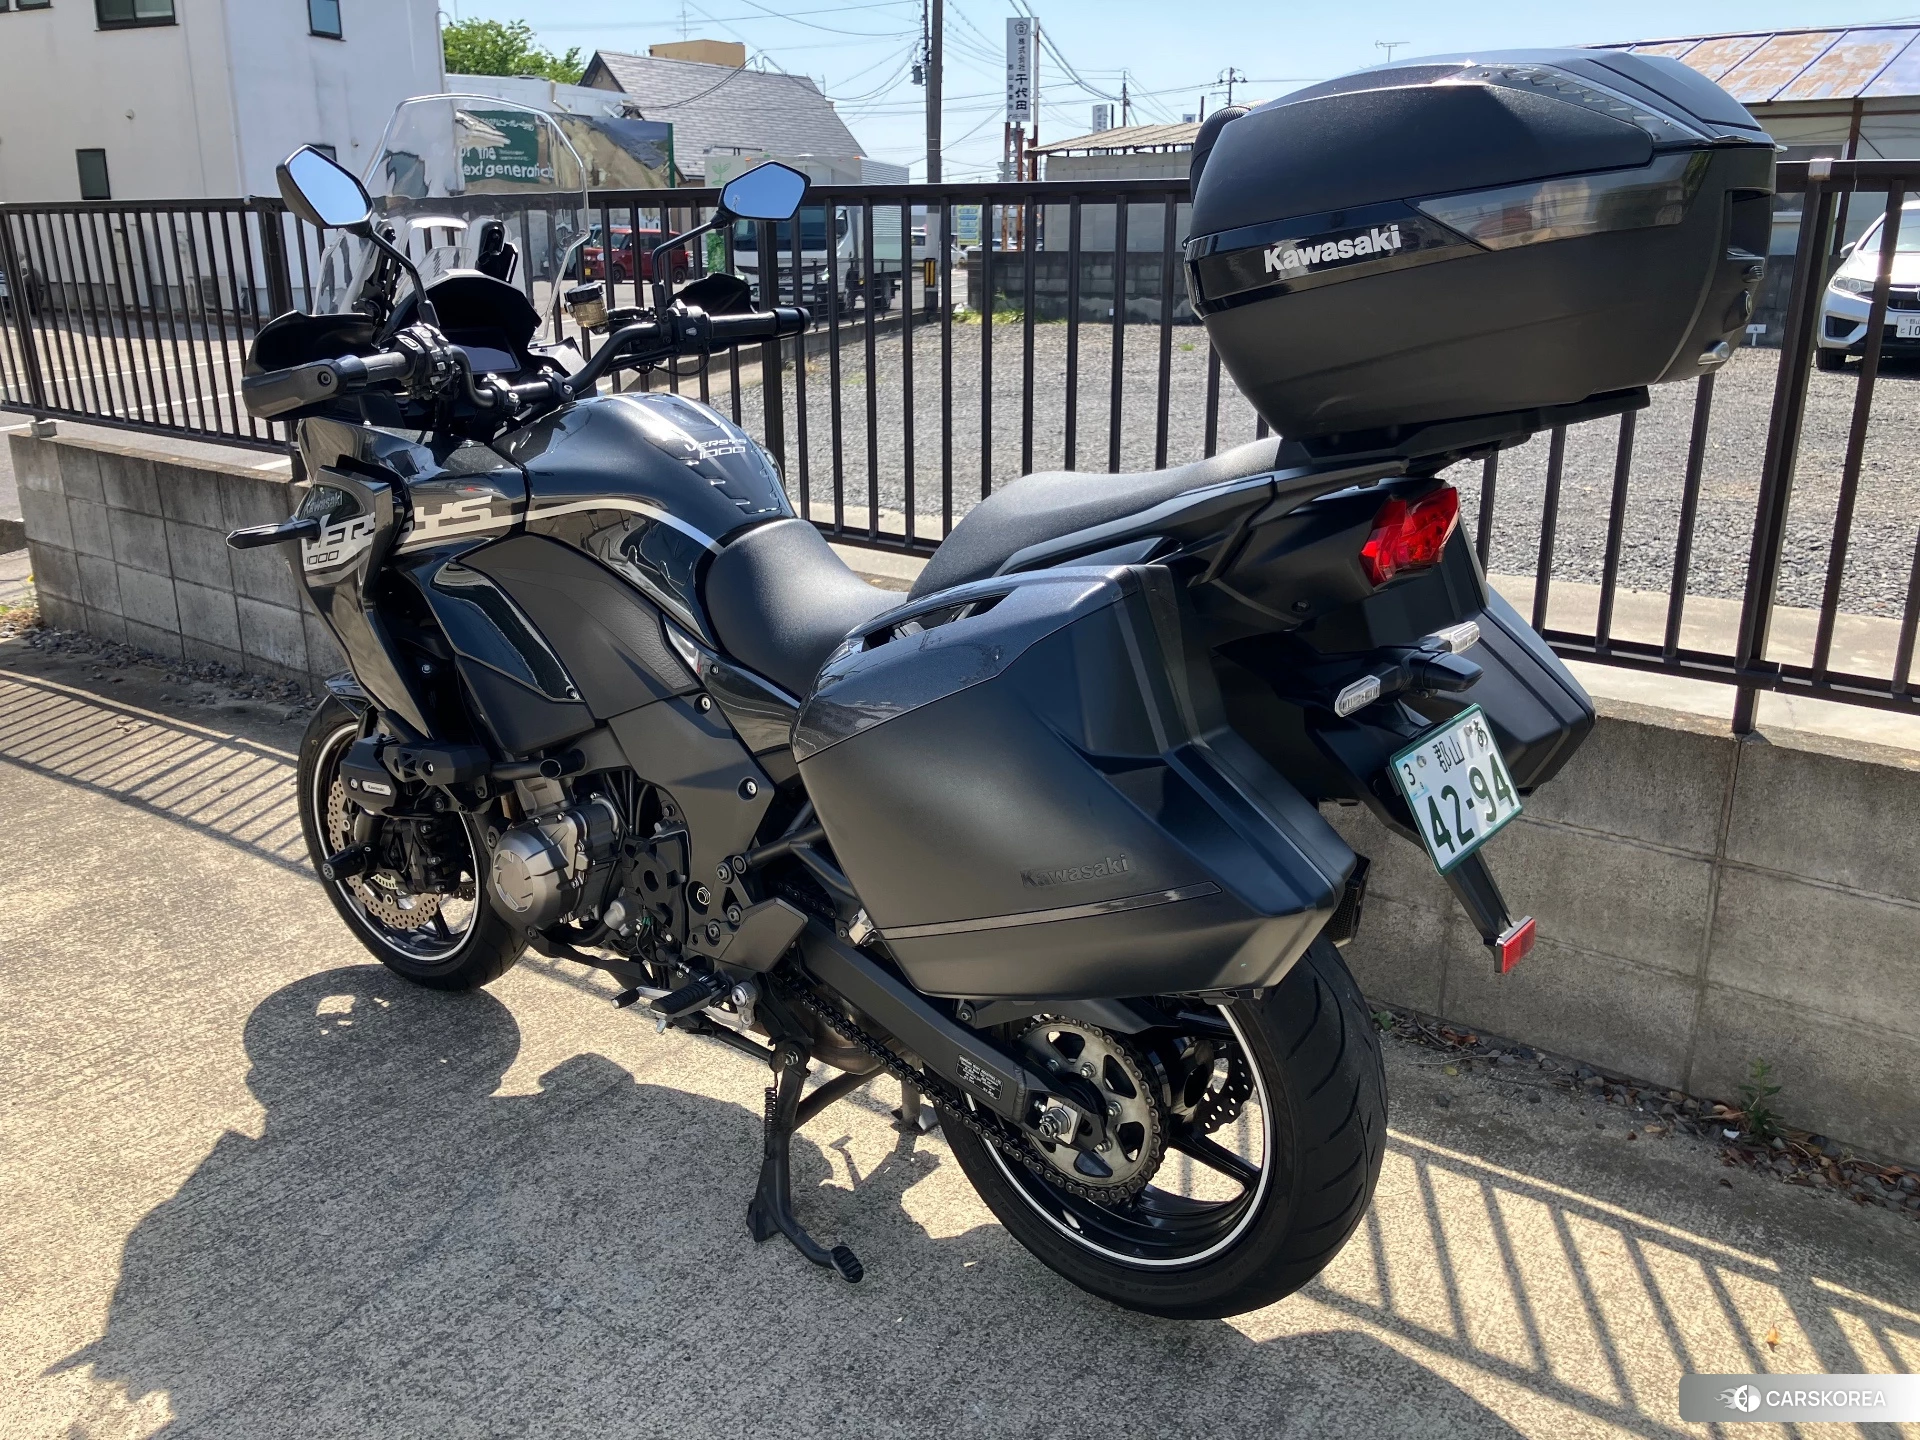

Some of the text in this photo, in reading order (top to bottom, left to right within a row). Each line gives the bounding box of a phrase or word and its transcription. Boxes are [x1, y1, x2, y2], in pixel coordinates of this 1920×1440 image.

[1264, 224, 1402, 273] Kawasaki
[684, 438, 747, 452] VERSYS
[700, 446, 746, 460] 1000
[307, 550, 339, 565] 1000
[1432, 735, 1465, 773] 郡山
[1403, 763, 1416, 786] 3
[1427, 752, 1514, 854] 42-94
[1020, 854, 1129, 888] Kawasaki
